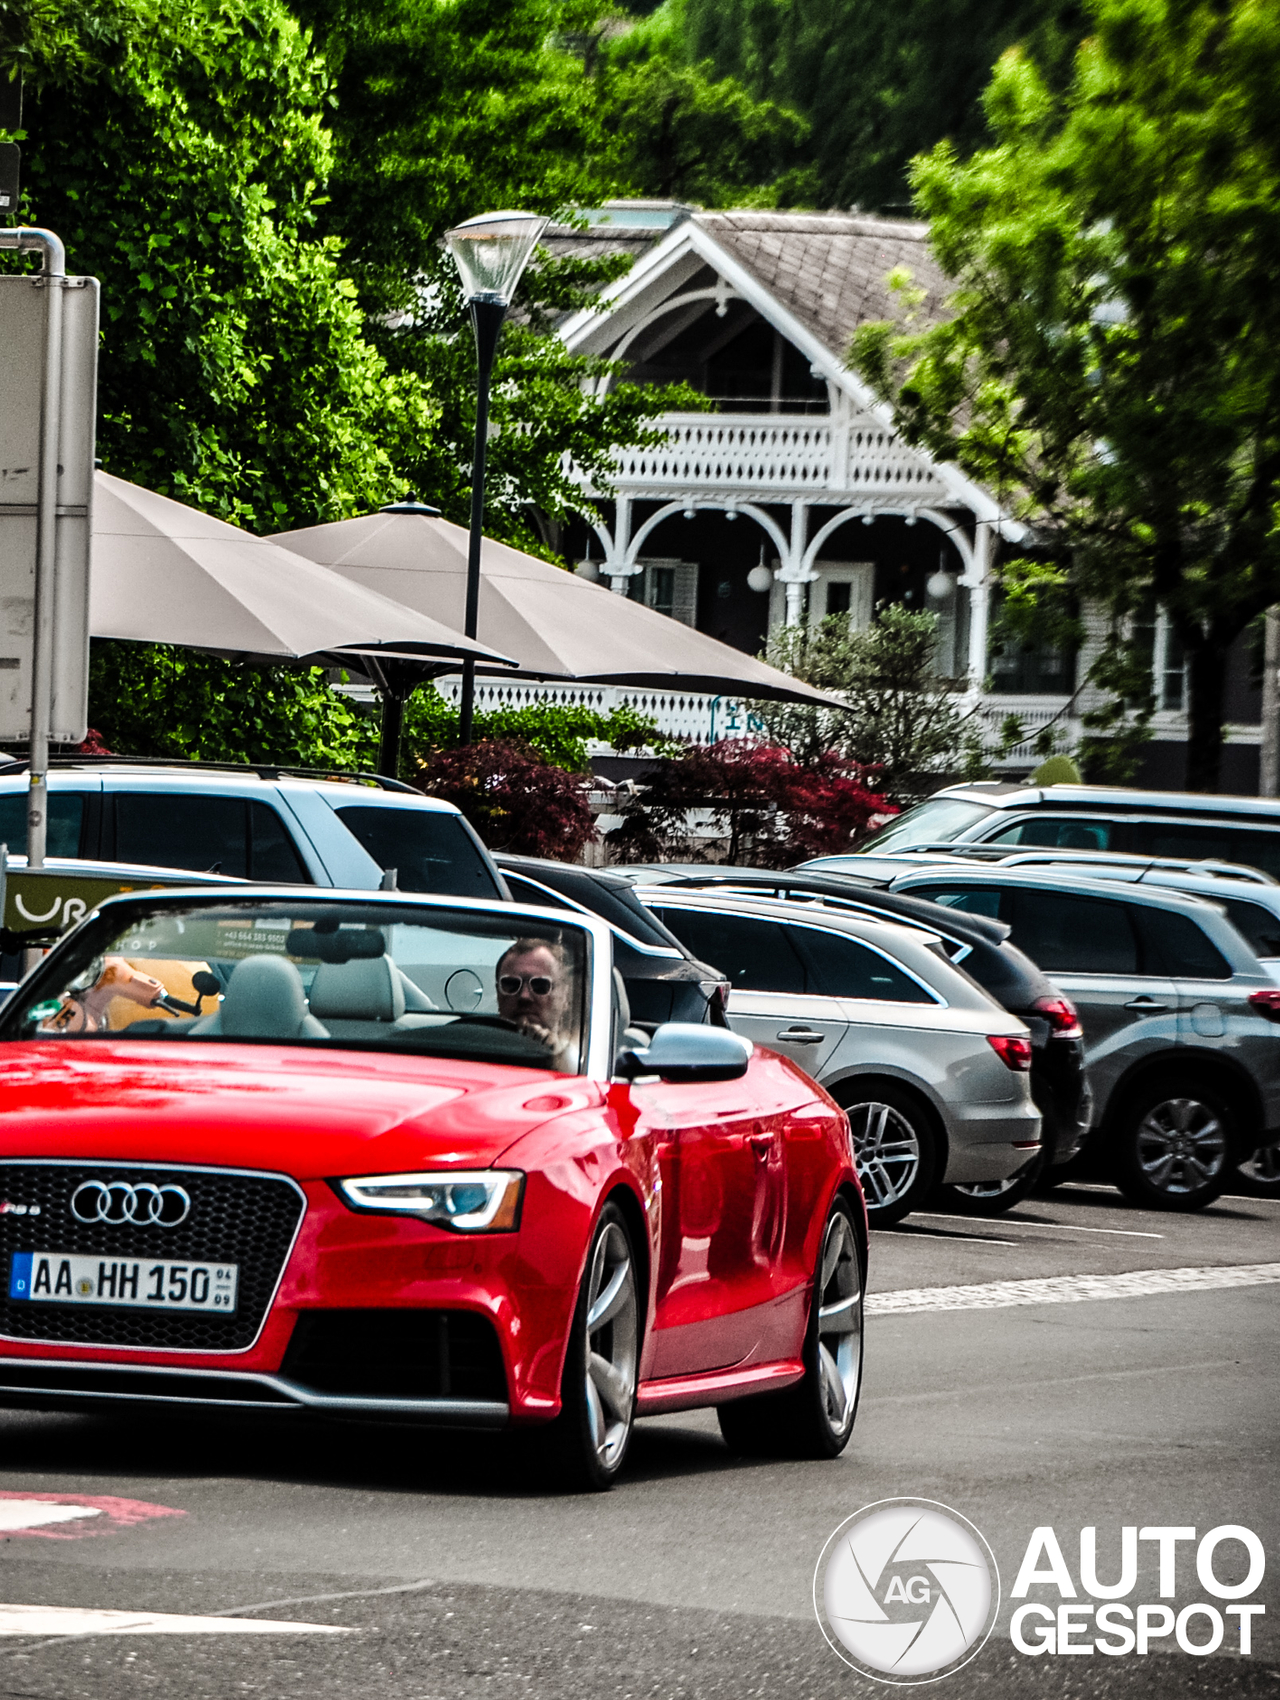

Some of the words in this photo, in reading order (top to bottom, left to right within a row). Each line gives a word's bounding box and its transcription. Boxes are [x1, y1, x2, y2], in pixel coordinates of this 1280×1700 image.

[33, 1259, 72, 1295] AA
[98, 1261, 139, 1299] HH
[147, 1264, 210, 1304] 150
